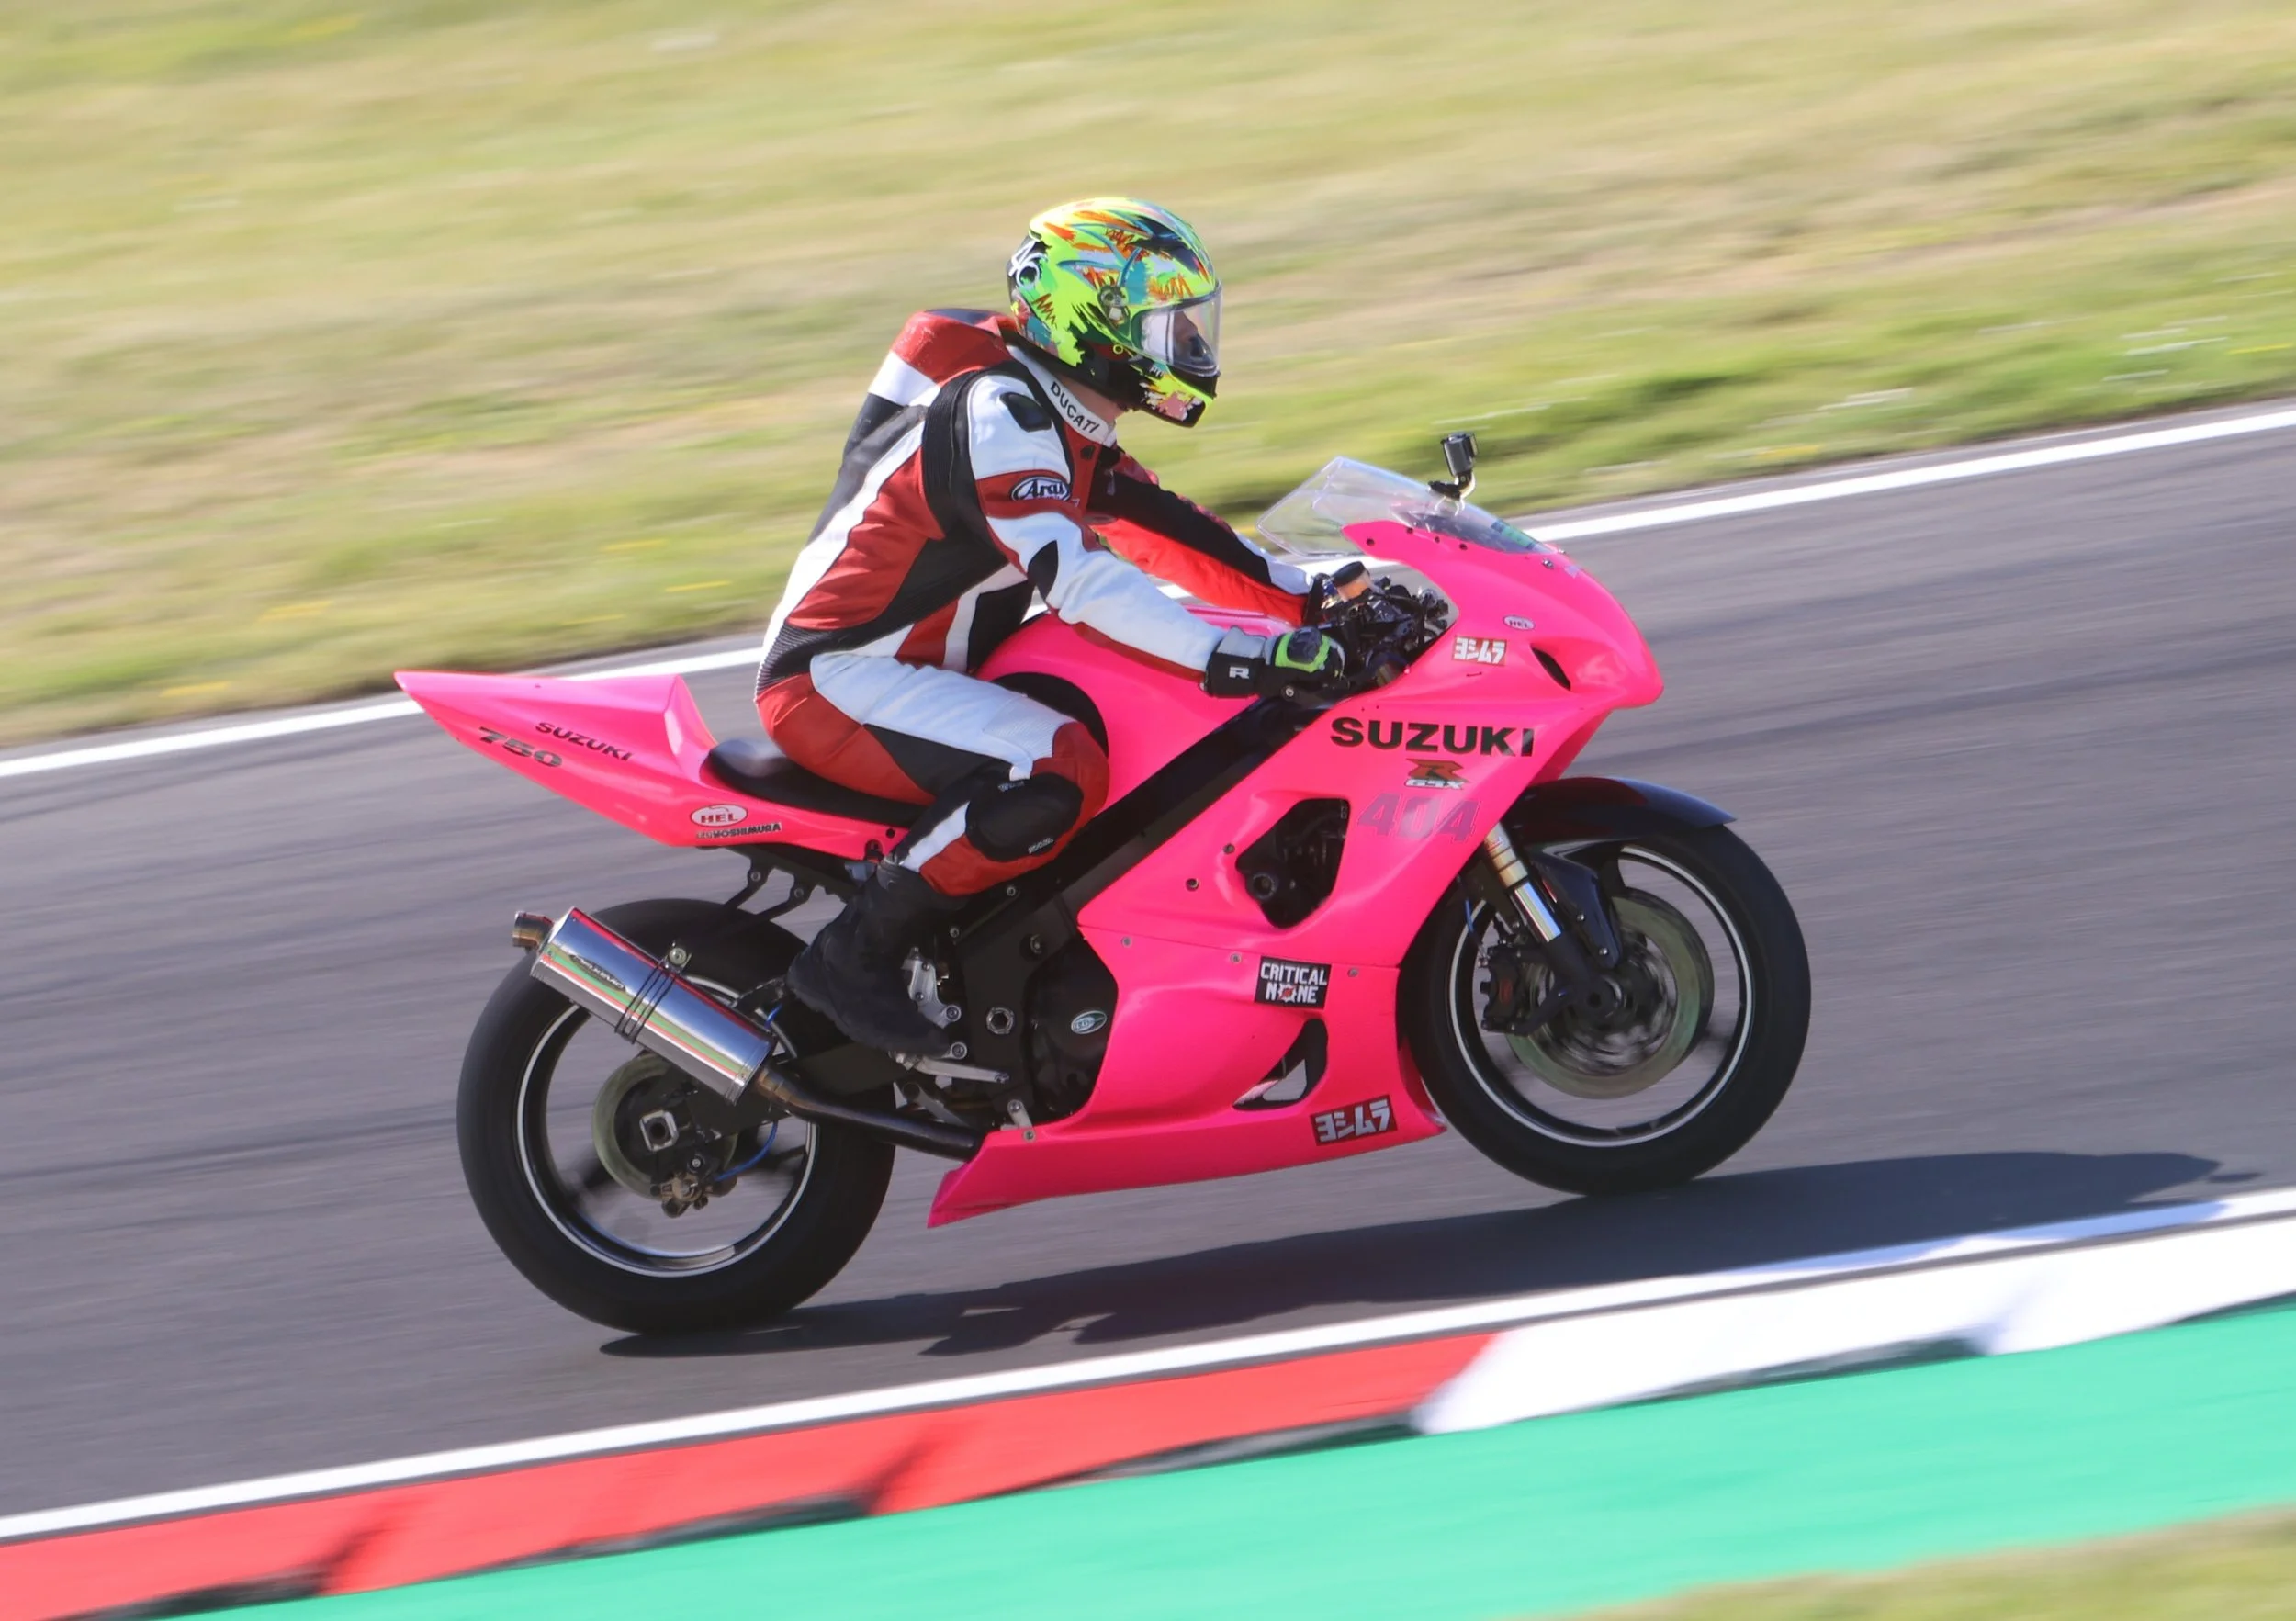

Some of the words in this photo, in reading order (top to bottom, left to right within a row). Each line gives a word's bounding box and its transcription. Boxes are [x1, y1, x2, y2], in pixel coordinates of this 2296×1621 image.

[1051, 381, 1100, 433] DUCATI
[1019, 478, 1064, 500] Arai
[479, 726, 563, 768] 750
[535, 721, 635, 762] SUZUKI
[1331, 717, 1536, 757] SUZUKI
[701, 813, 738, 824] HEL
[1356, 792, 1482, 842] 404
[1260, 962, 1328, 985] CRITICAL
